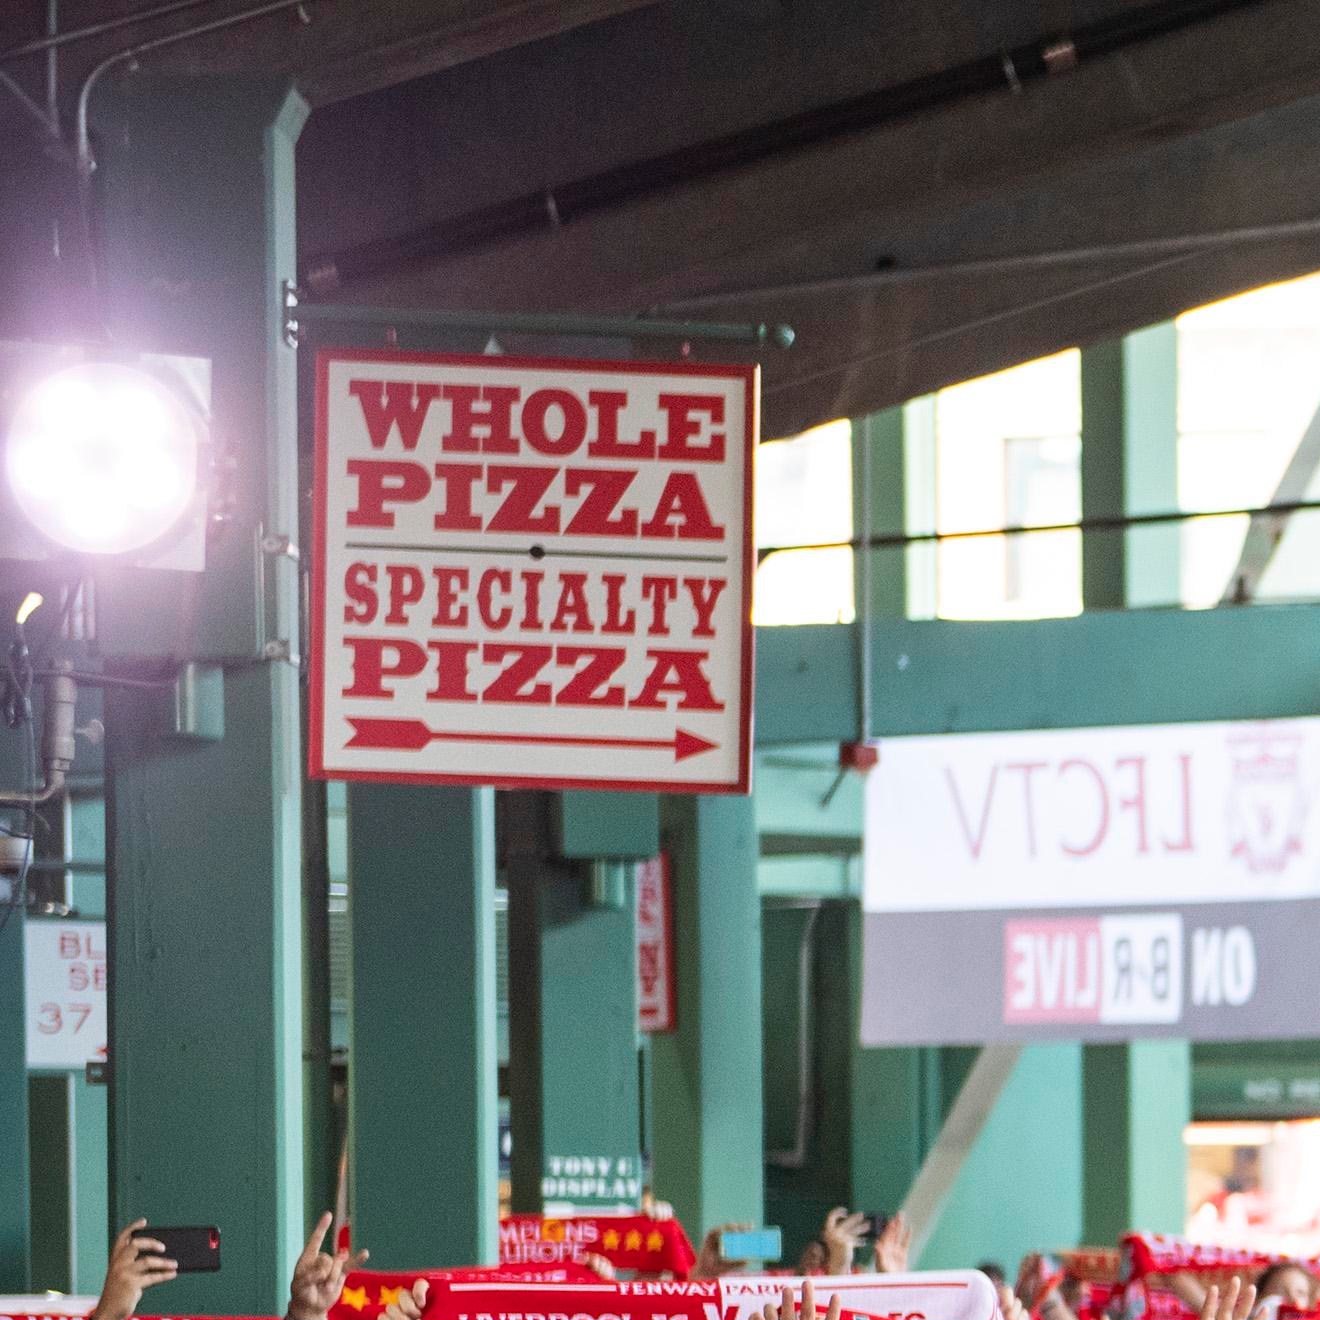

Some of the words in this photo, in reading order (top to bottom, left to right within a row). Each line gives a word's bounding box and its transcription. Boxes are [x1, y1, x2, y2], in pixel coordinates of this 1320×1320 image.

[348, 379, 726, 462] WHOLE
[345, 459, 725, 541] PIZZA
[344, 561, 727, 638] SPECIALTY
[342, 637, 725, 712] PIZZA
[37, 1002, 92, 1035] 37
[542, 1177, 641, 1199] DISPLAY
[618, 1281, 717, 1297] FENWAY
